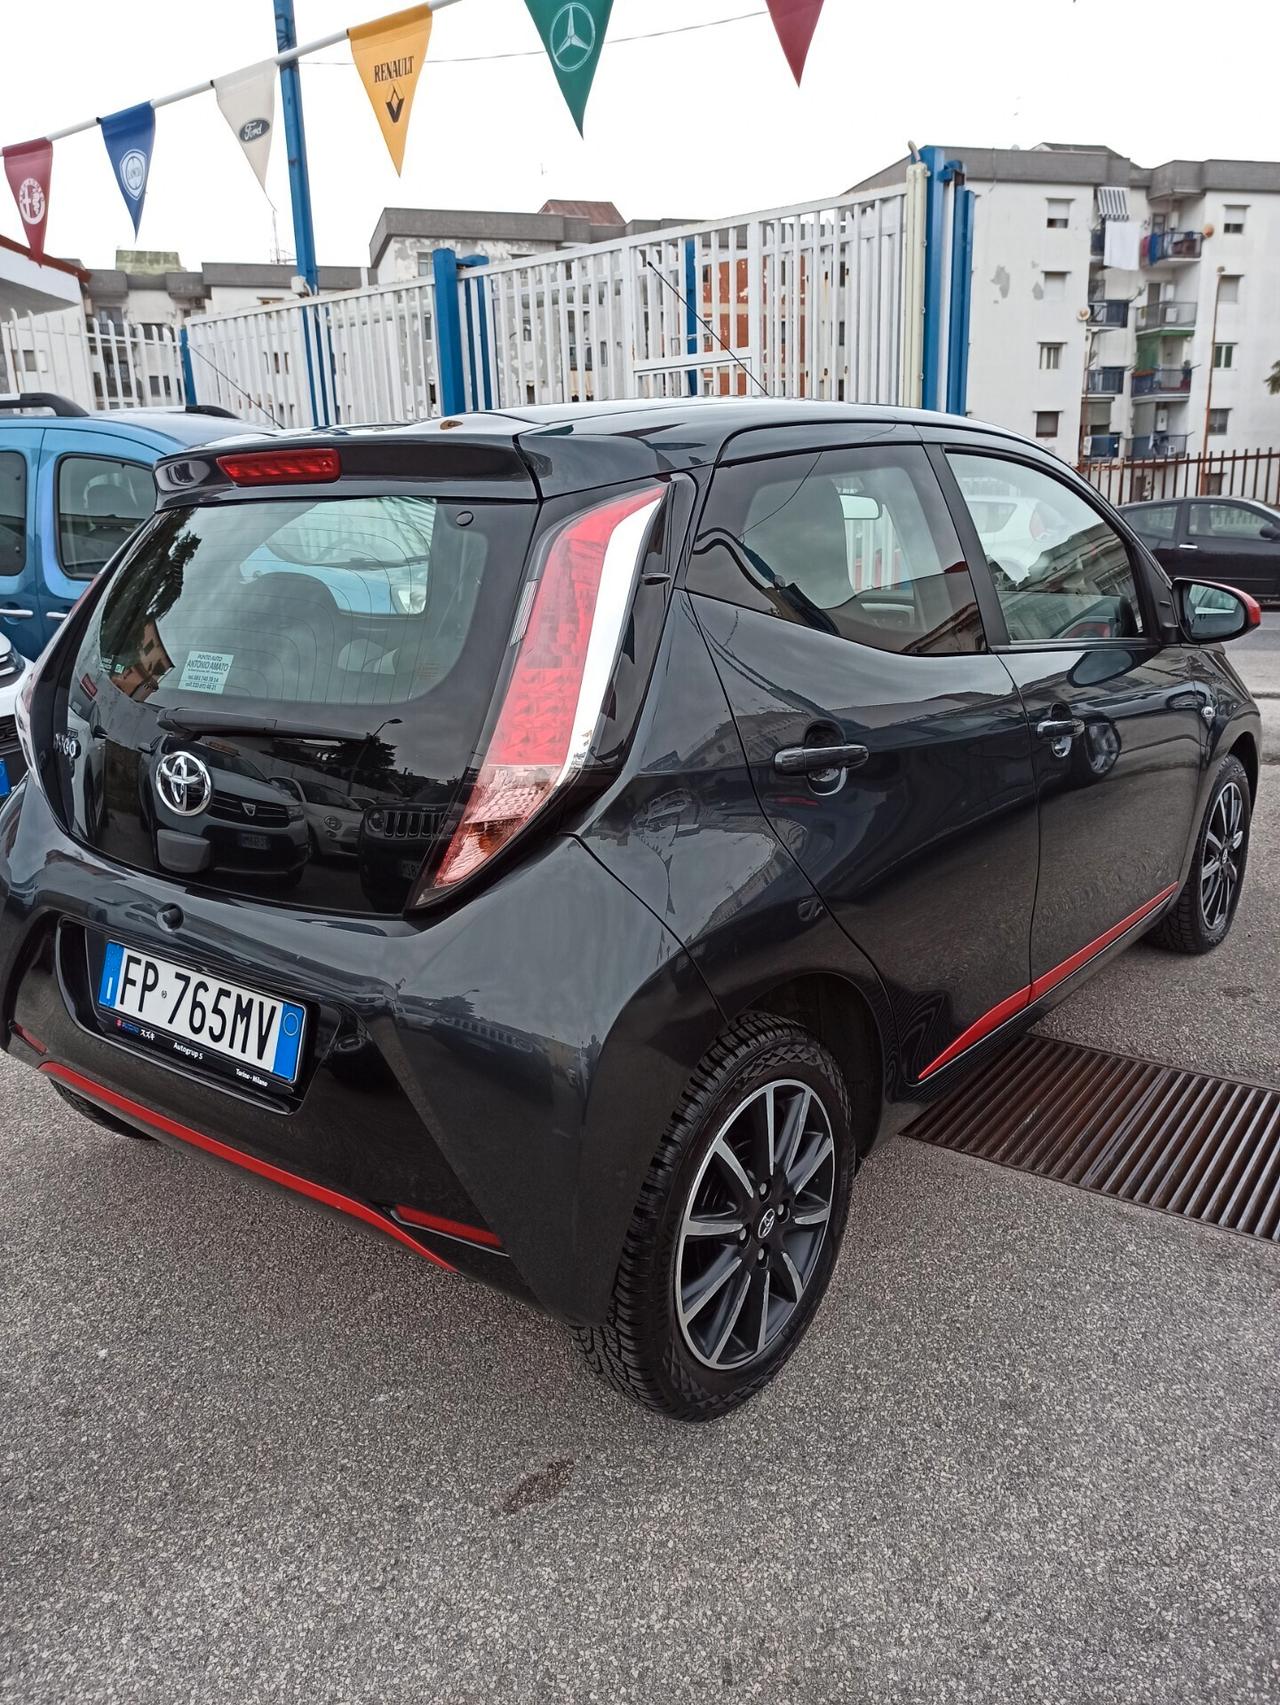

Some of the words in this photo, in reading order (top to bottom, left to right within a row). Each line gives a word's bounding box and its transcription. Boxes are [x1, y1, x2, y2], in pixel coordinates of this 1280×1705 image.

[374, 56, 414, 83] RENAULT
[244, 121, 263, 140] Ford
[187, 659, 210, 670] ANTONIO
[210, 660, 229, 671] AMATO
[119, 954, 160, 1013] FP
[168, 972, 277, 1061] 765MV
[173, 1042, 199, 1059] Autogrup
[236, 1068, 250, 1080] Torino
[252, 1075, 268, 1087] Milano
